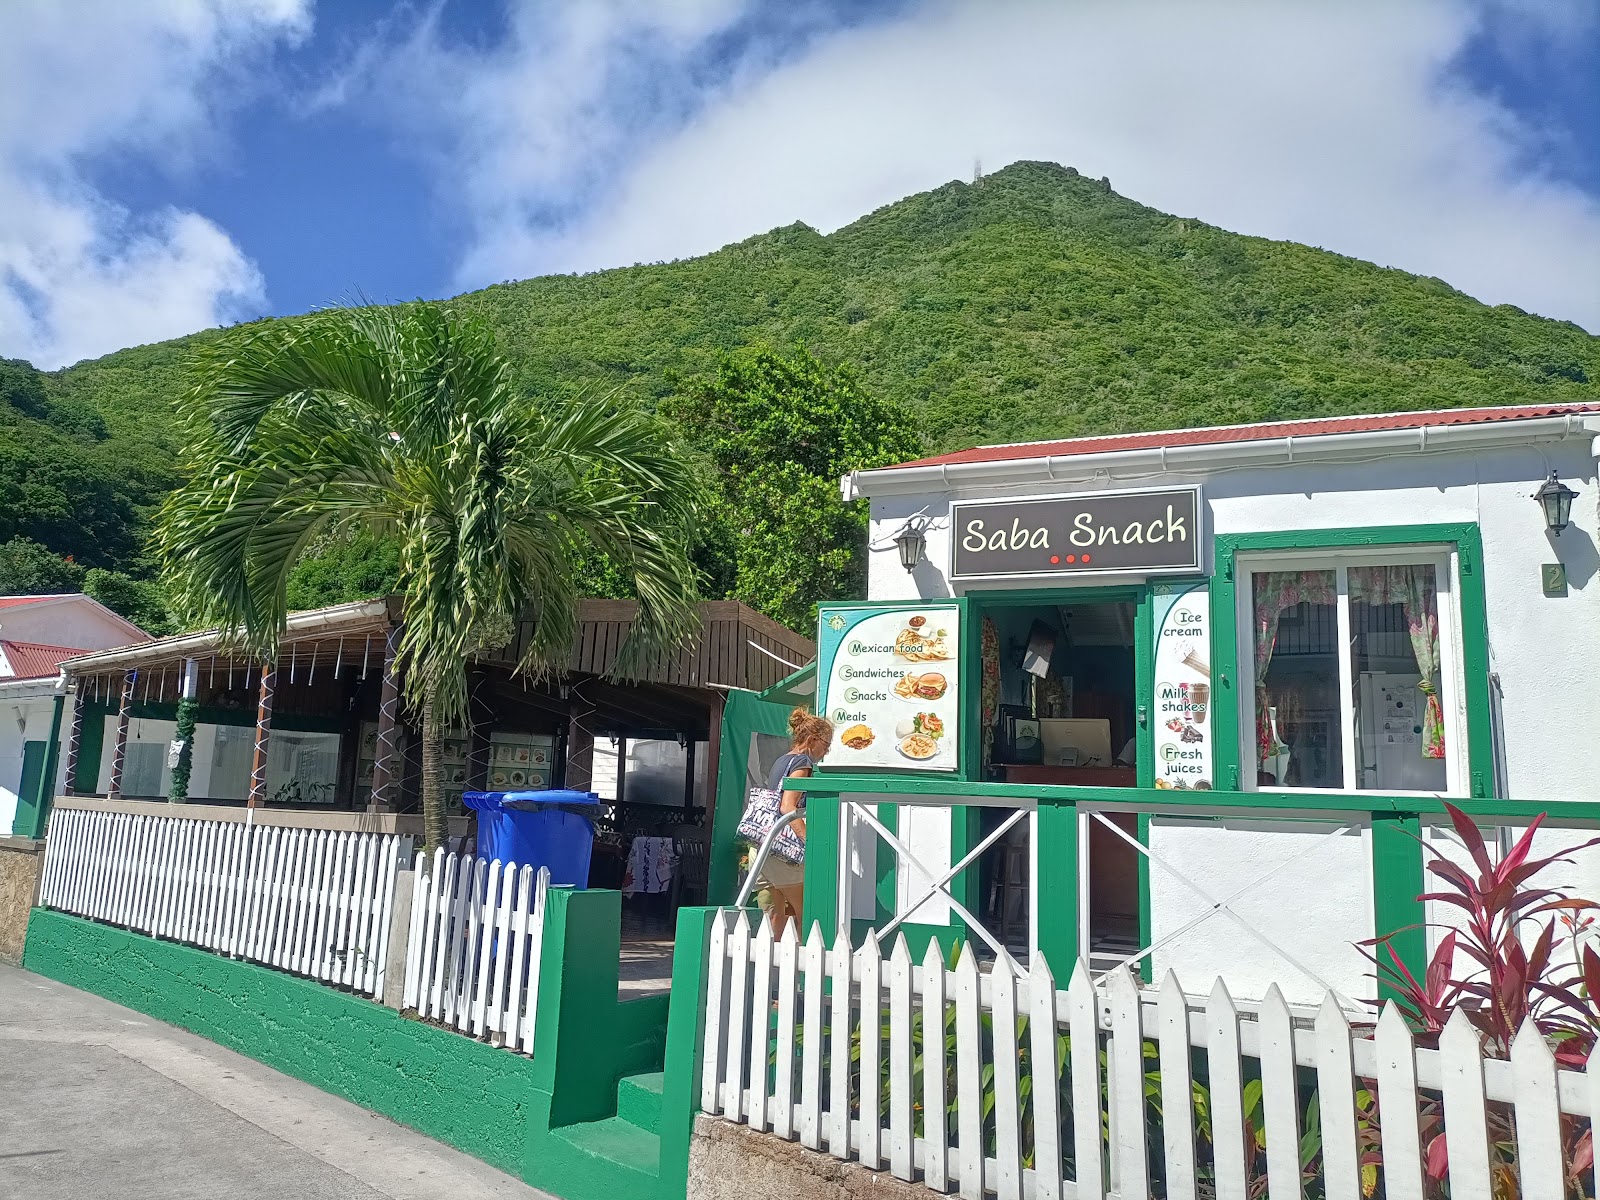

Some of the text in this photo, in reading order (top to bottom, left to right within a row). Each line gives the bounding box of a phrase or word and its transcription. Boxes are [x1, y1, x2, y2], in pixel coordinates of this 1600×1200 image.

[962, 504, 1187, 552] Saba Snack
[1549, 568, 1562, 589] 2
[1180, 612, 1202, 623] Ice
[1164, 628, 1202, 636] cream
[852, 644, 923, 653] Mexican food
[845, 669, 904, 678] Sandwiches
[850, 692, 887, 701] Snacks
[1162, 688, 1189, 699] Milk
[1162, 702, 1206, 712] shakes
[836, 712, 866, 721] Meals
[1166, 748, 1202, 759] Fresh
[1165, 762, 1203, 775] juices
